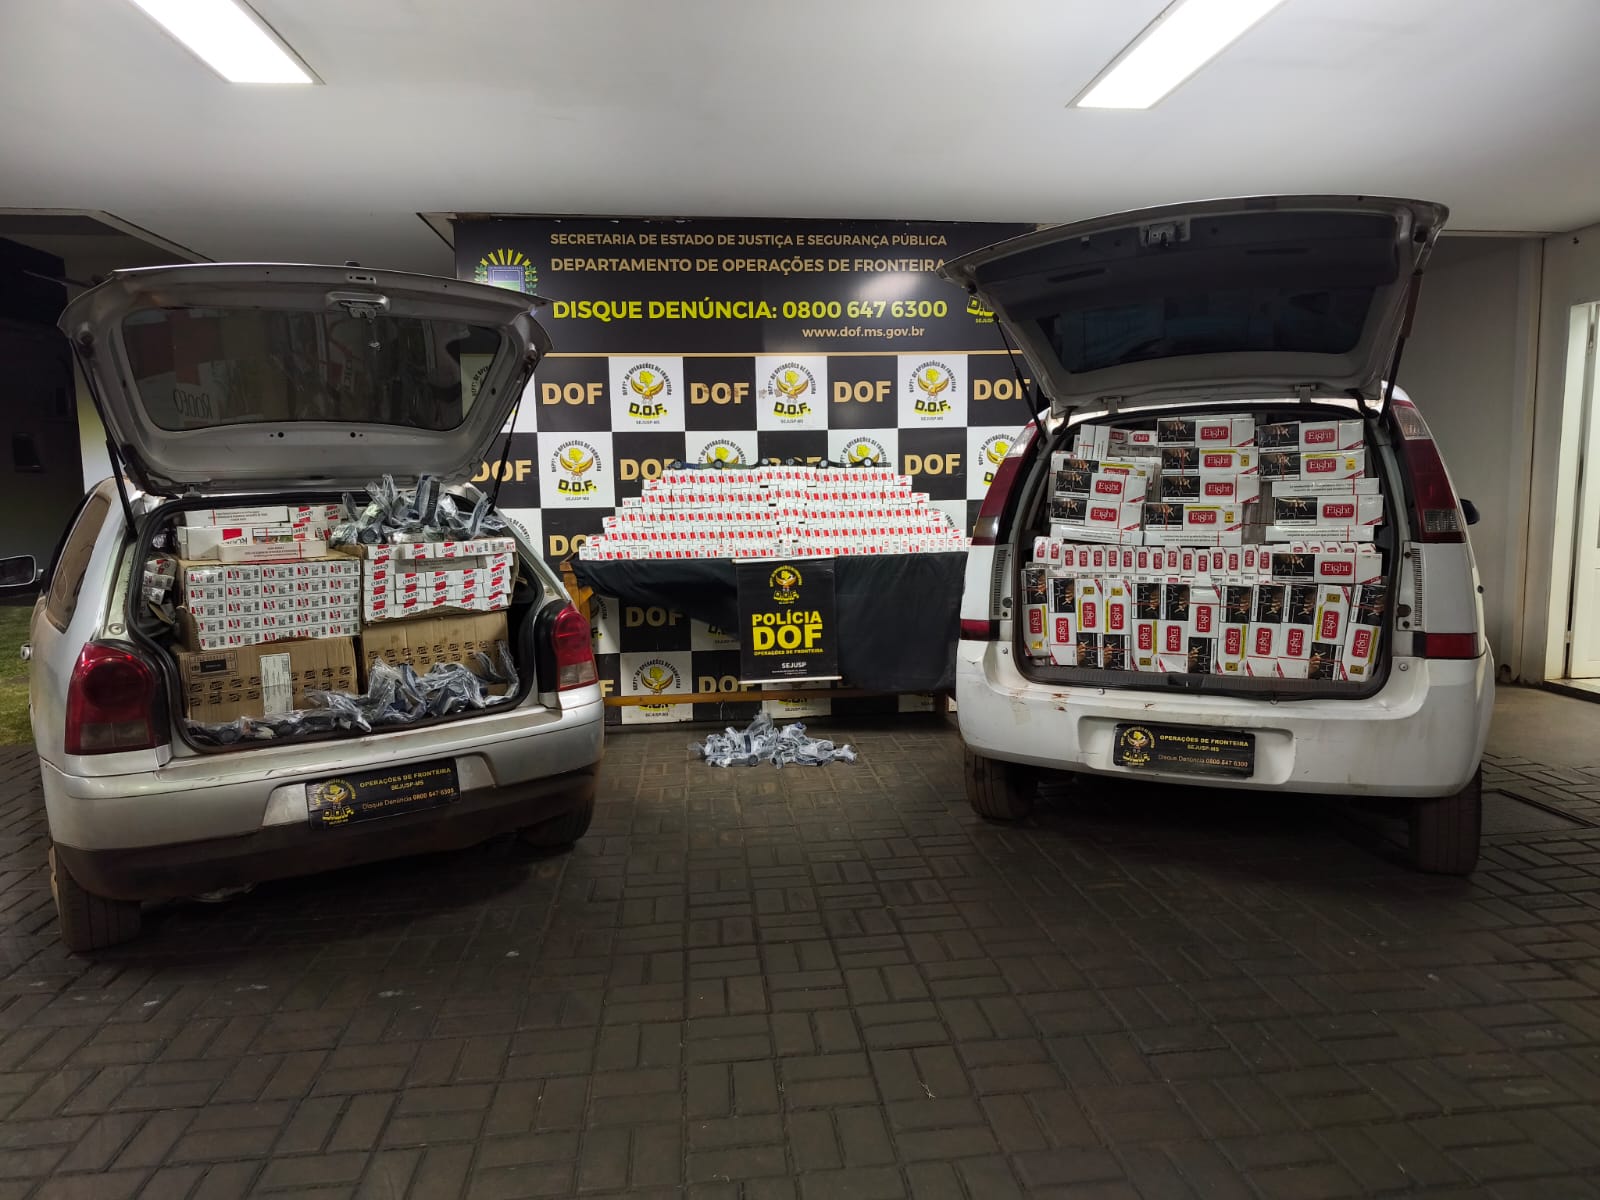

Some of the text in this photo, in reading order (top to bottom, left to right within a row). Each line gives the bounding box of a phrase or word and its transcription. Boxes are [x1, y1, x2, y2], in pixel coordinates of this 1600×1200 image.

[550, 232, 947, 248] SECRETARIA DE ESTADO DE JUSTIÇA E SEGURANÇA PÚBLICA
[551, 256, 946, 275] DEPARTAMENTO DE OPERAÇÕES DE FRONTEIRA
[553, 300, 642, 322] DISQUE
[648, 297, 778, 319] DENÚNCIA:
[782, 300, 842, 318] 0800
[847, 300, 886, 318] 647
[890, 300, 948, 318] 6300
[802, 326, 925, 340] www.dof.ms.gov.br
[542, 382, 603, 405] DOF
[690, 382, 750, 405] DOF
[833, 380, 892, 403] DOF
[973, 378, 1031, 401] DOF
[629, 402, 667, 416] D.O.F.
[774, 402, 811, 416] D.O.F.
[914, 400, 951, 412] D.O.F.
[1204, 428, 1225, 438] Eight
[1308, 431, 1332, 441] Eight
[904, 453, 961, 475] DOF
[1207, 456, 1229, 466] Eight
[1309, 461, 1333, 471] Eight
[558, 478, 597, 492] D.O.F.
[1098, 482, 1119, 492] Eight
[1208, 484, 1230, 495] Eight
[1093, 509, 1114, 519] Eight
[1191, 513, 1213, 523] Eight
[1326, 506, 1351, 516] Eight
[550, 534, 586, 556] DO
[1324, 563, 1348, 574] Eight
[625, 606, 686, 628] DOF
[752, 609, 822, 626] POLÍCIA
[1032, 611, 1040, 631] Eight
[1085, 606, 1094, 625] Eight
[1112, 607, 1122, 627] Eight
[1198, 609, 1210, 630] Eight
[1324, 614, 1336, 636] Eight
[752, 624, 823, 650] DOF
[1057, 621, 1067, 640] Eight
[1140, 627, 1150, 647] Eight
[1169, 628, 1179, 649] Eight
[1228, 631, 1238, 652] Eight
[1259, 631, 1270, 652] Eight
[1290, 632, 1302, 653] Eight
[1356, 633, 1369, 655] Eight
[1160, 734, 1198, 743] OPERAÇÕES
[1210, 739, 1248, 747] FRONTEIRA
[360, 775, 402, 788] OPERAÇÕES
[414, 768, 451, 778] FRONTEIRA
